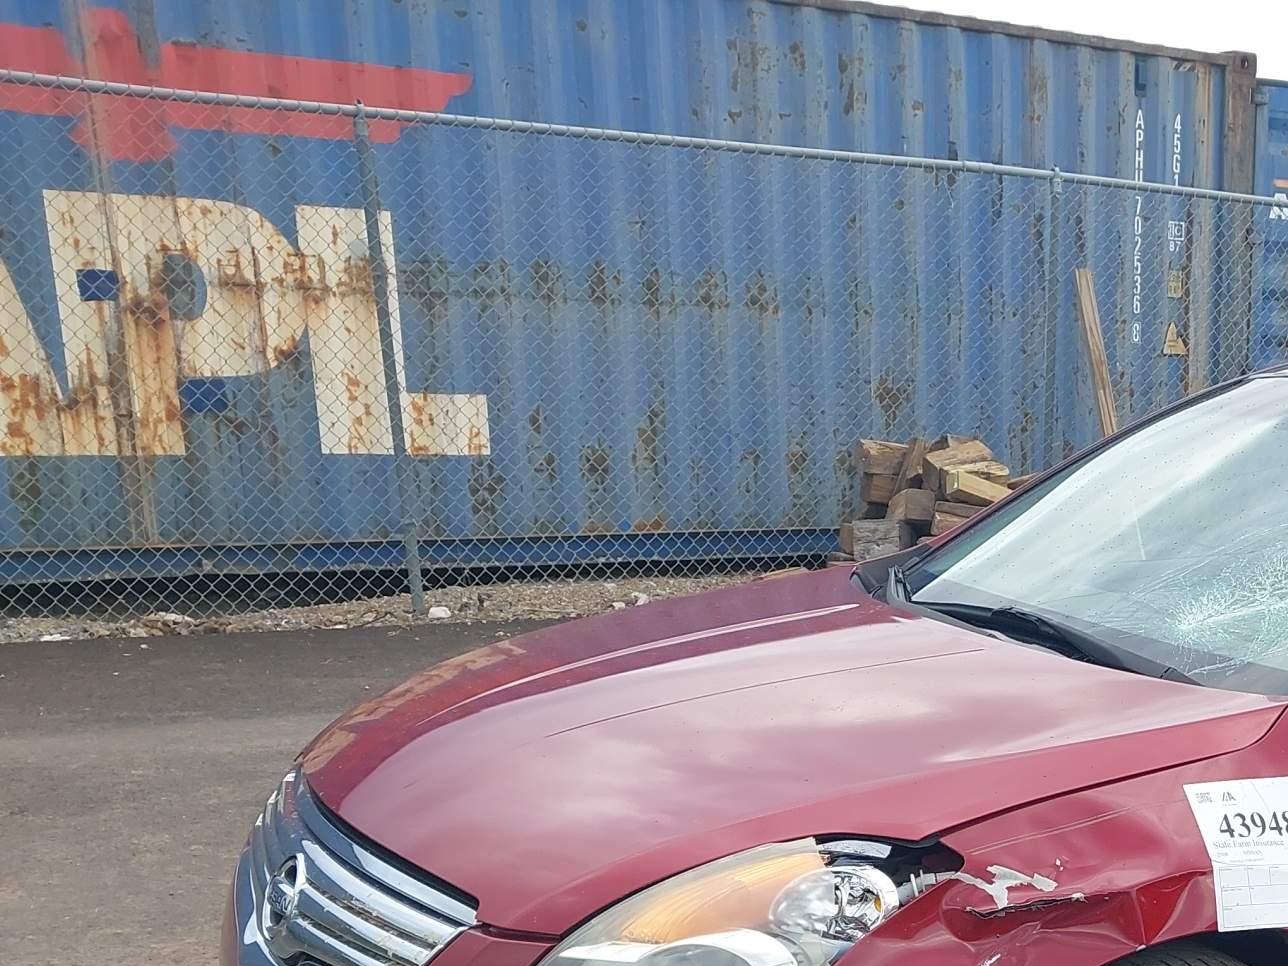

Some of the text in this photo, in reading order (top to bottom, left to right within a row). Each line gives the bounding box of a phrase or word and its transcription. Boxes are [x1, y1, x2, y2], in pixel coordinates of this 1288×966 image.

[1173, 113, 1181, 187] 45G1
[1133, 196, 1142, 314] 702536
[1132, 323, 1141, 342] 8
